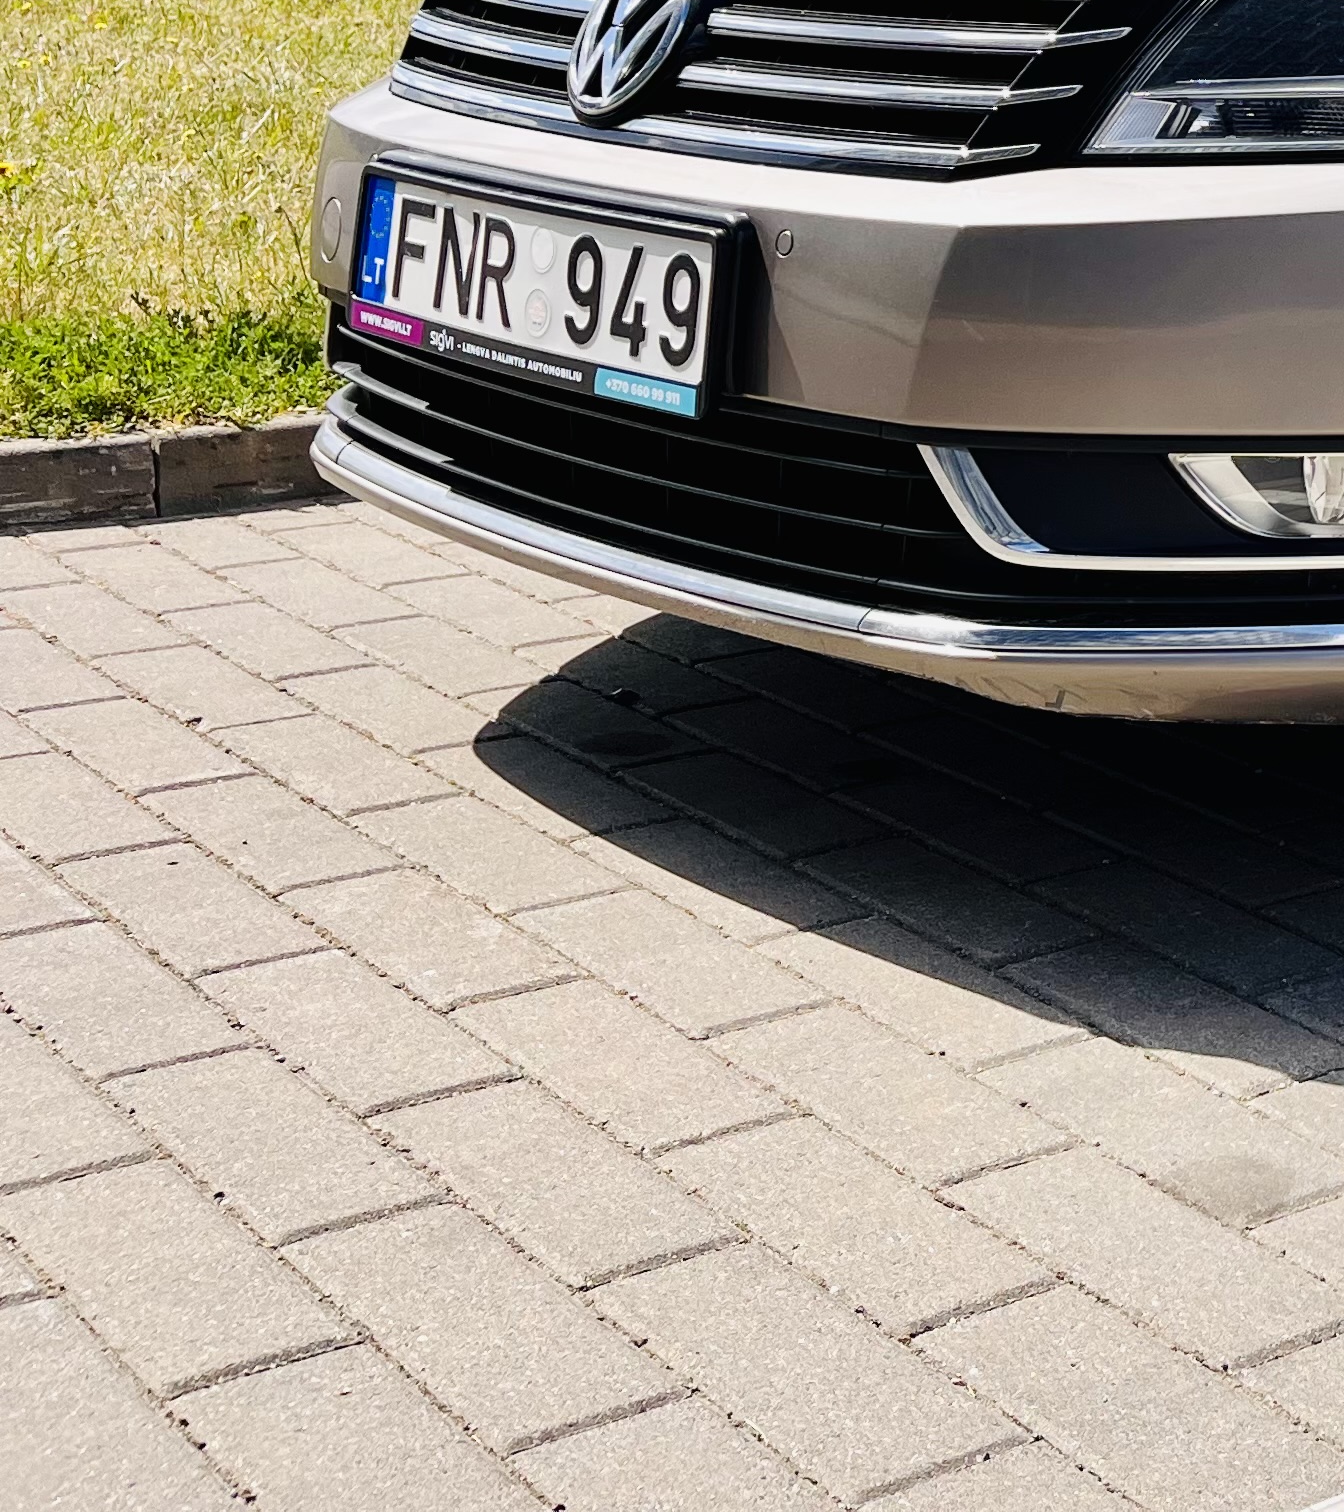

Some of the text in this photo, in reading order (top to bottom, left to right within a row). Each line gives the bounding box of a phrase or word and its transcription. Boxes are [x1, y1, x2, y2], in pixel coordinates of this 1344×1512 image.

[361, 254, 385, 284] LT
[391, 193, 700, 366] FNR 949
[492, 350, 526, 368] DALINTIS
[651, 388, 664, 402] 99
[665, 391, 680, 406] 911
